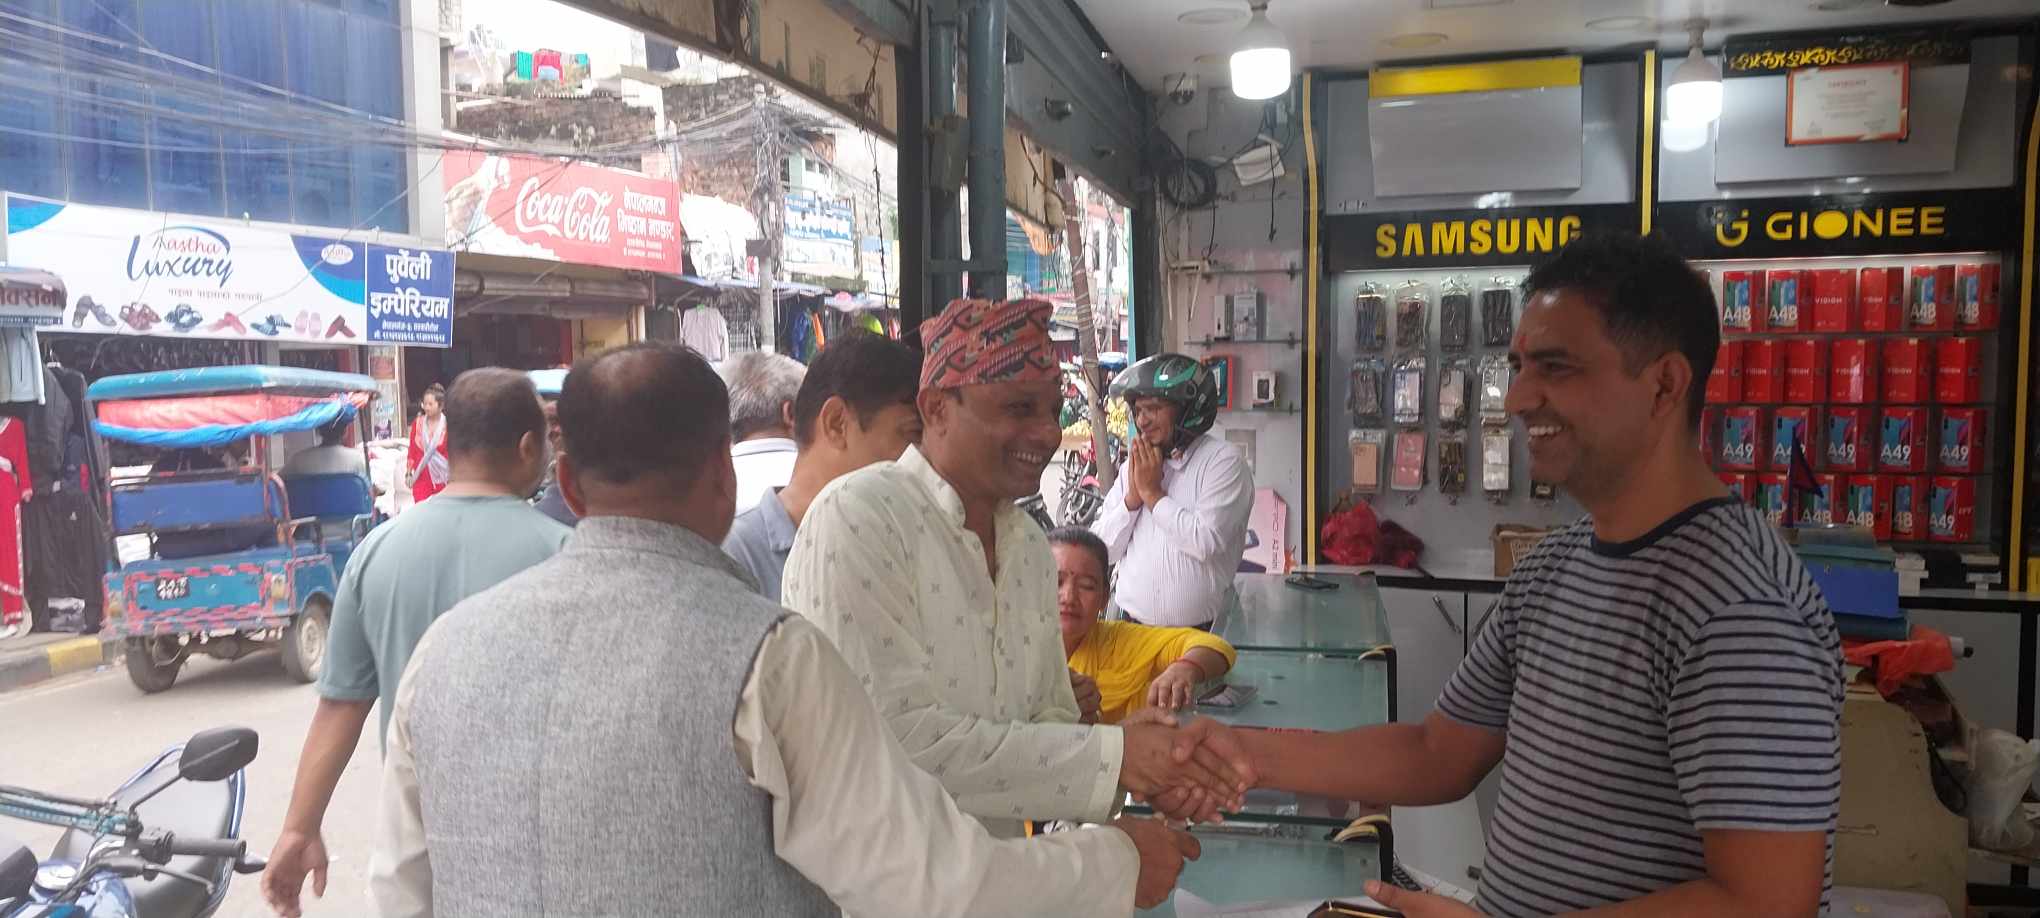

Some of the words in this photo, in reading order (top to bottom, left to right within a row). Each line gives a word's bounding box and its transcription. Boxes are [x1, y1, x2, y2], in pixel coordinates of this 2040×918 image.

[1765, 207, 1945, 240] GIONEE
[1723, 305, 1751, 321] A48
[1768, 305, 1798, 321] A48
[1911, 302, 1936, 319] A48
[1723, 442, 1753, 458] A49
[1827, 442, 1855, 459] A49
[1881, 443, 1911, 460] A49
[1940, 444, 1969, 460] A49
[1846, 510, 1874, 527] A48
[1930, 512, 1955, 529] A49
